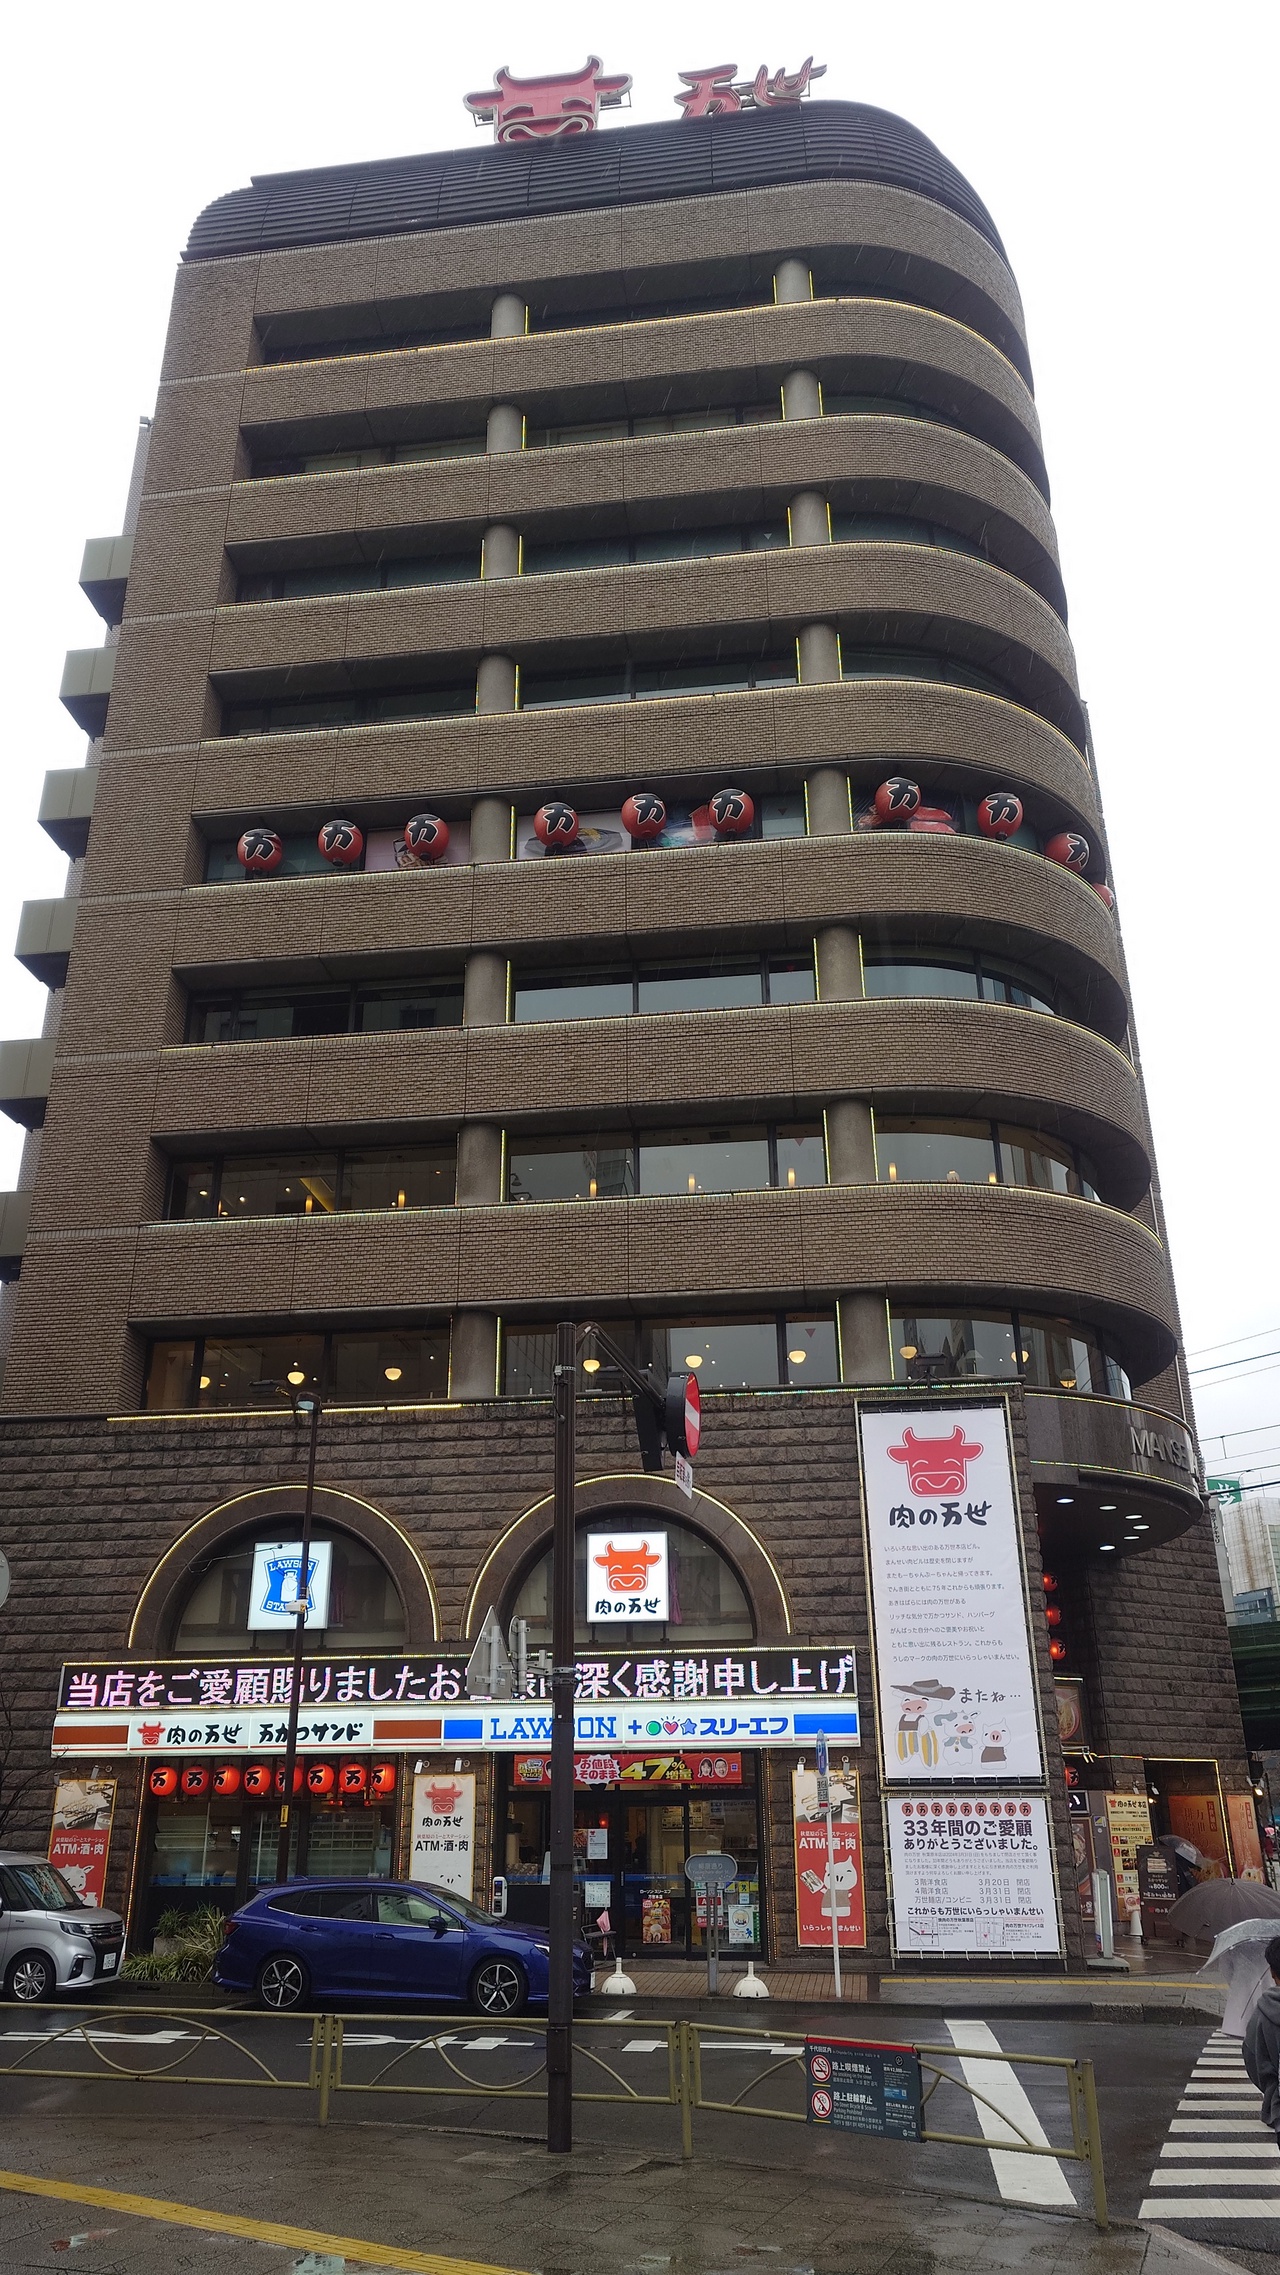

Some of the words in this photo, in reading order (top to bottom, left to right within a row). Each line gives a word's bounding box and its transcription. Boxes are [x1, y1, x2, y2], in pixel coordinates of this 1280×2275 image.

[889, 776, 920, 810] 万
[632, 793, 665, 825] 万
[715, 788, 745, 822] 万
[990, 794, 1022, 826] 万
[543, 802, 576, 836] 万
[323, 819, 357, 853] 万
[408, 813, 442, 847] 万
[243, 828, 281, 861] 万
[889, 1501, 992, 1529] 肉の万世
[269, 1559, 314, 1572] LAWSN
[595, 1597, 661, 1615] 肉の万世
[66, 1654, 853, 1707] 当店をご愛顧賜りましたお深く感謝申し上げ
[166, 1723, 243, 1745] 肉の万世
[490, 1716, 617, 1739] LAWON
[700, 1717, 789, 1735] スリーエフ
[580, 1758, 614, 1770] お値段
[152, 1771, 167, 1789] 万
[187, 1771, 203, 1789] 万
[213, 1770, 226, 1788] 万
[247, 1770, 261, 1788] 万
[309, 1768, 323, 1787] 万
[345, 1768, 361, 1787] 万
[372, 1768, 384, 1786] 万
[578, 1769, 619, 1780] そのまま
[422, 1815, 464, 1827] 肉の万世
[903, 1819, 1033, 1837] 33年間のご愛顧
[903, 1838, 1038, 1850] ありがとうございました。
[978, 1878, 1010, 1886] 3月20日
[979, 1887, 1011, 1895] 3月31日
[979, 1896, 1012, 1904] 3月31日
[907, 1907, 1044, 1915] これからも万世にいらっしゃいまんせい
[802, 1924, 861, 1932] いらっしゃまんせい
[832, 2061, 872, 2074] 路上喫煙禁止
[833, 2091, 873, 2105] 路上駐輪禁止
